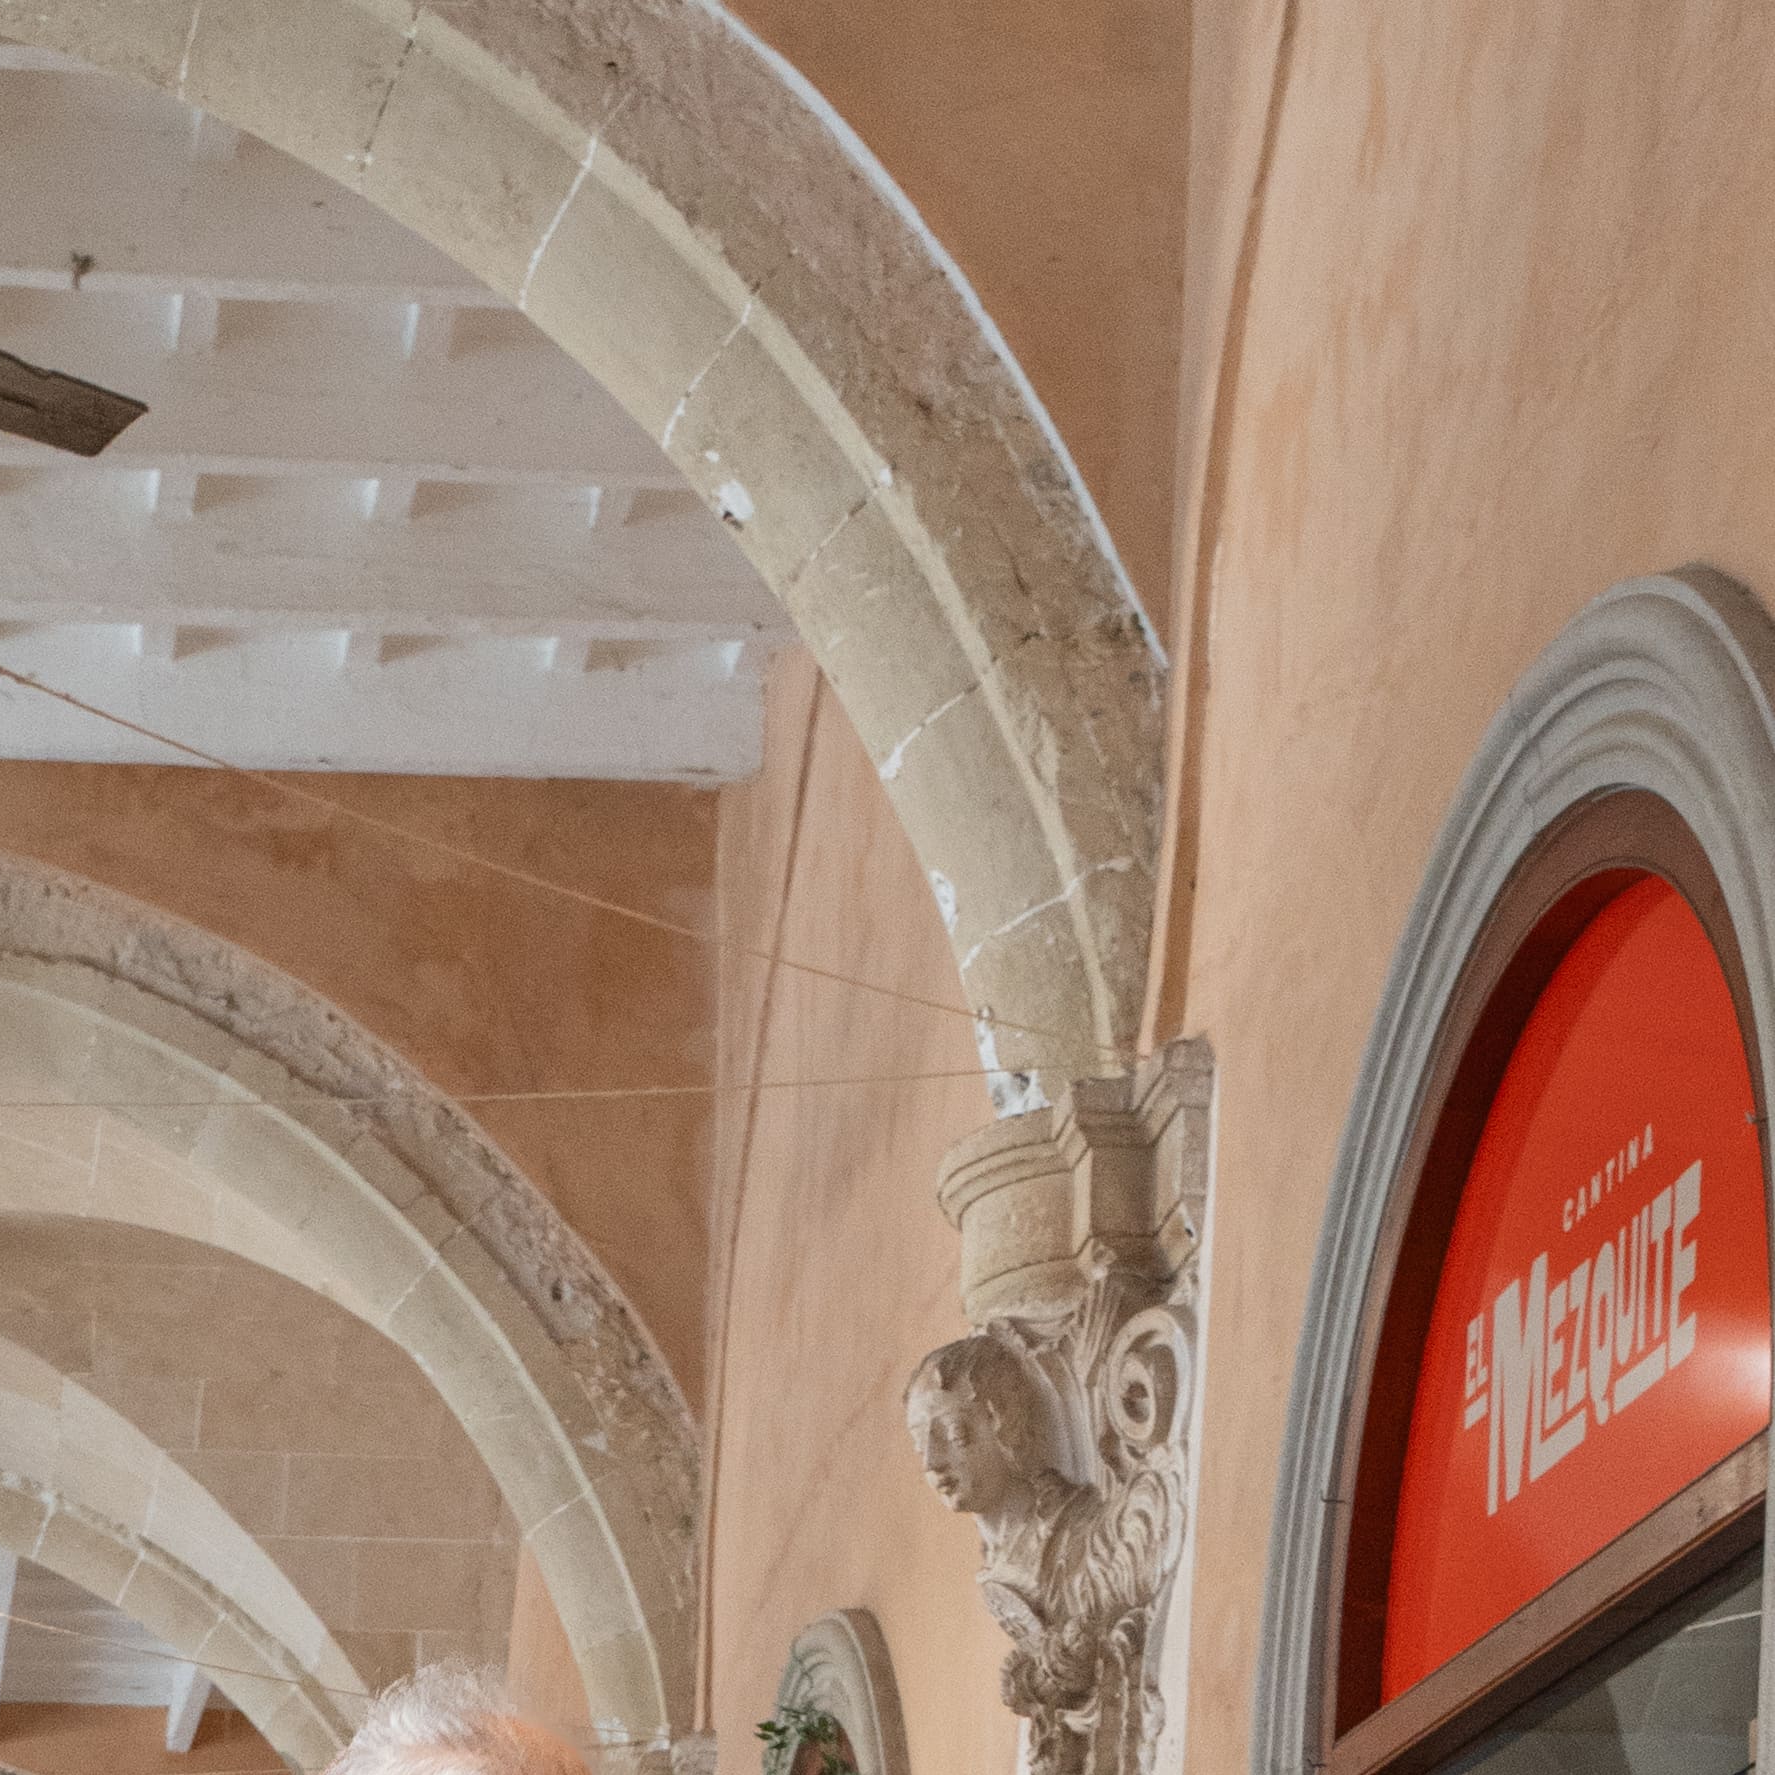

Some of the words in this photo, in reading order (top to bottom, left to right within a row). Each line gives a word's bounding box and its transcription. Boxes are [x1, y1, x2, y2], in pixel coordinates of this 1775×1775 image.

[1562, 1122, 1655, 1233] CANTINA
[1465, 1313, 1488, 1398] EL
[1487, 1159, 1703, 1517] MEZQUITE
